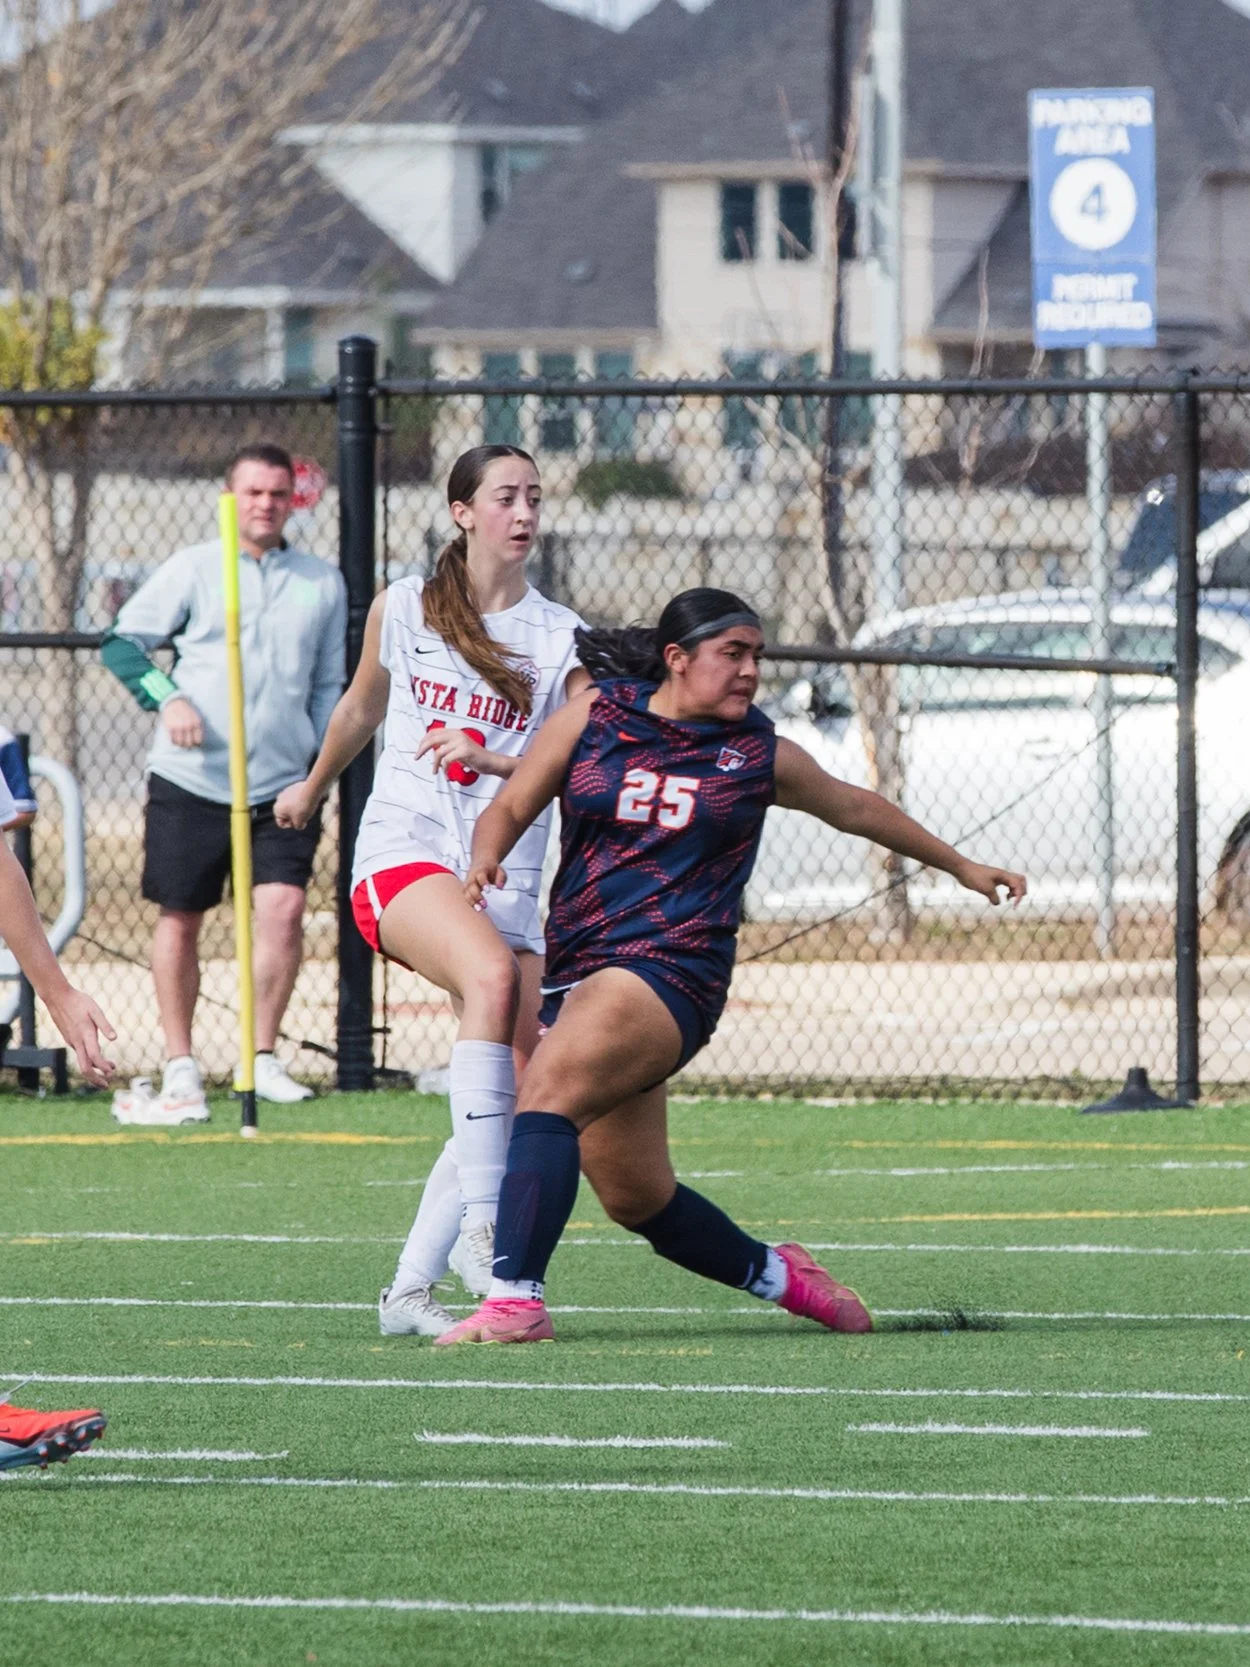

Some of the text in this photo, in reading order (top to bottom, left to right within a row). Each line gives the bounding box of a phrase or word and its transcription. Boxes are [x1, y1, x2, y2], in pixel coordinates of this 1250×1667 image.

[1080, 182, 1108, 222] 4
[410, 674, 458, 713] ISTA
[616, 768, 701, 830] 25
